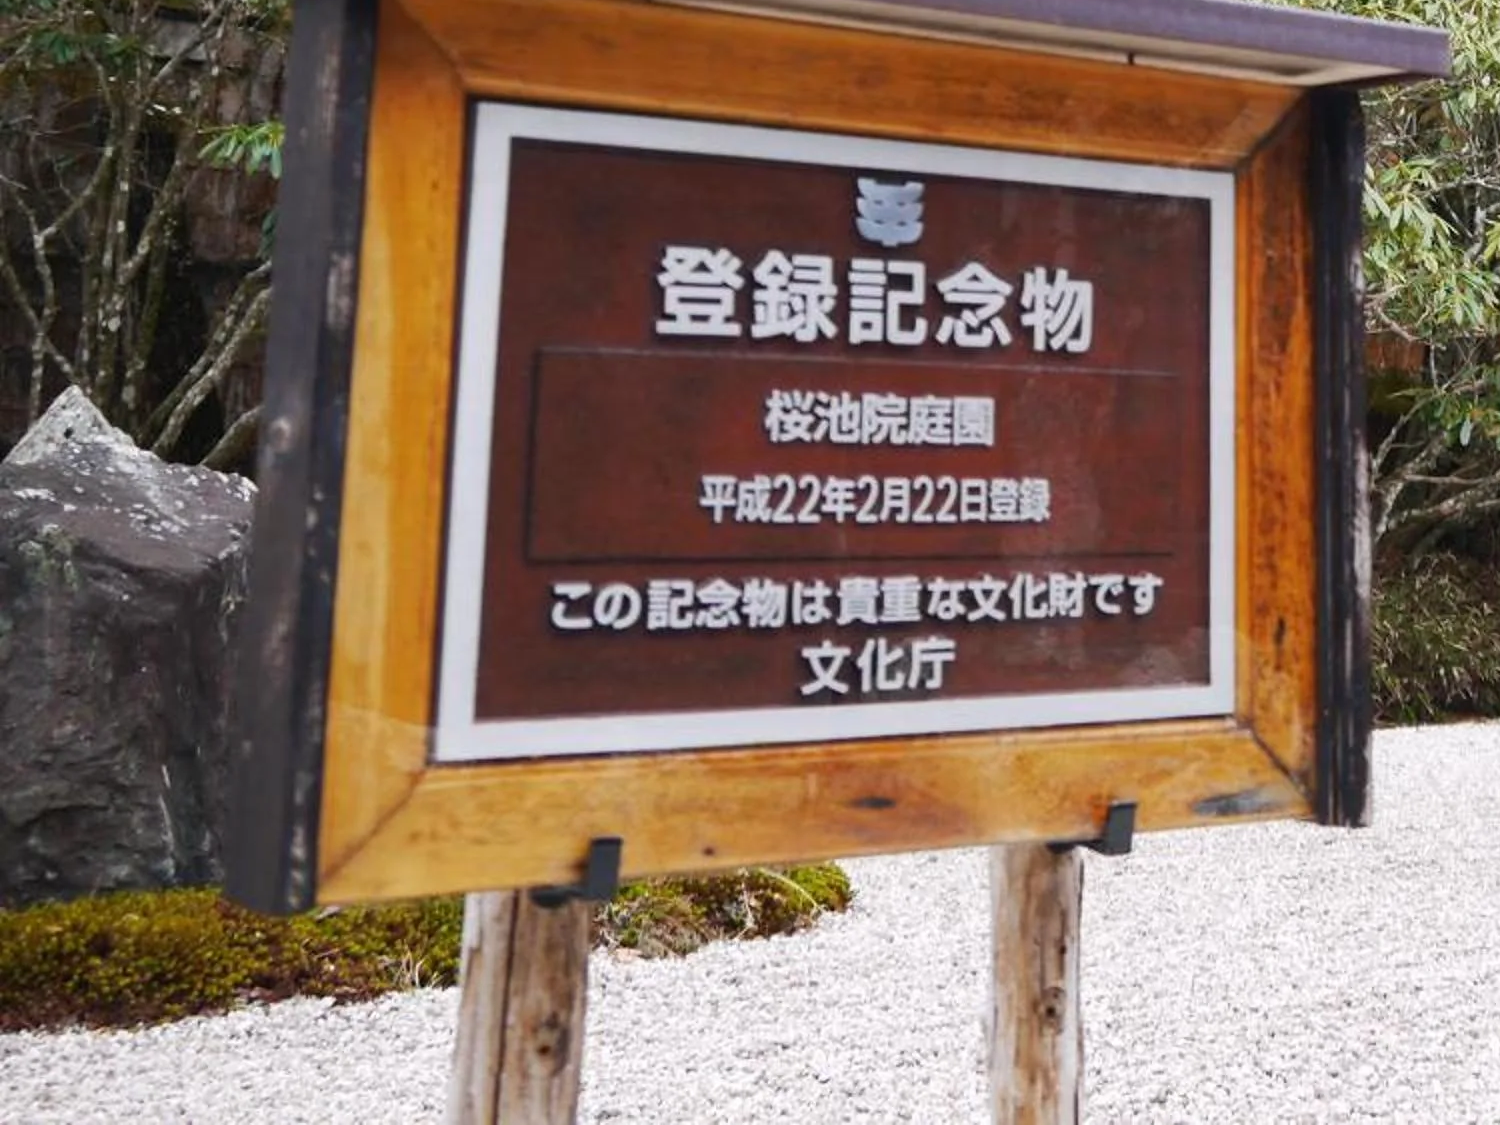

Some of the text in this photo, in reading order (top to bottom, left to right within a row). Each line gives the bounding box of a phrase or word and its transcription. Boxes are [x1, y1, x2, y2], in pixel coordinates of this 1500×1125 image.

[655, 246, 1094, 352] 登録記念物
[764, 389, 995, 446] 桜池院庭園
[699, 475, 1051, 523] 平成22年2月22日登録
[551, 573, 1163, 630] この記念物は貴重な文化財です
[801, 637, 956, 695] 文化庁
